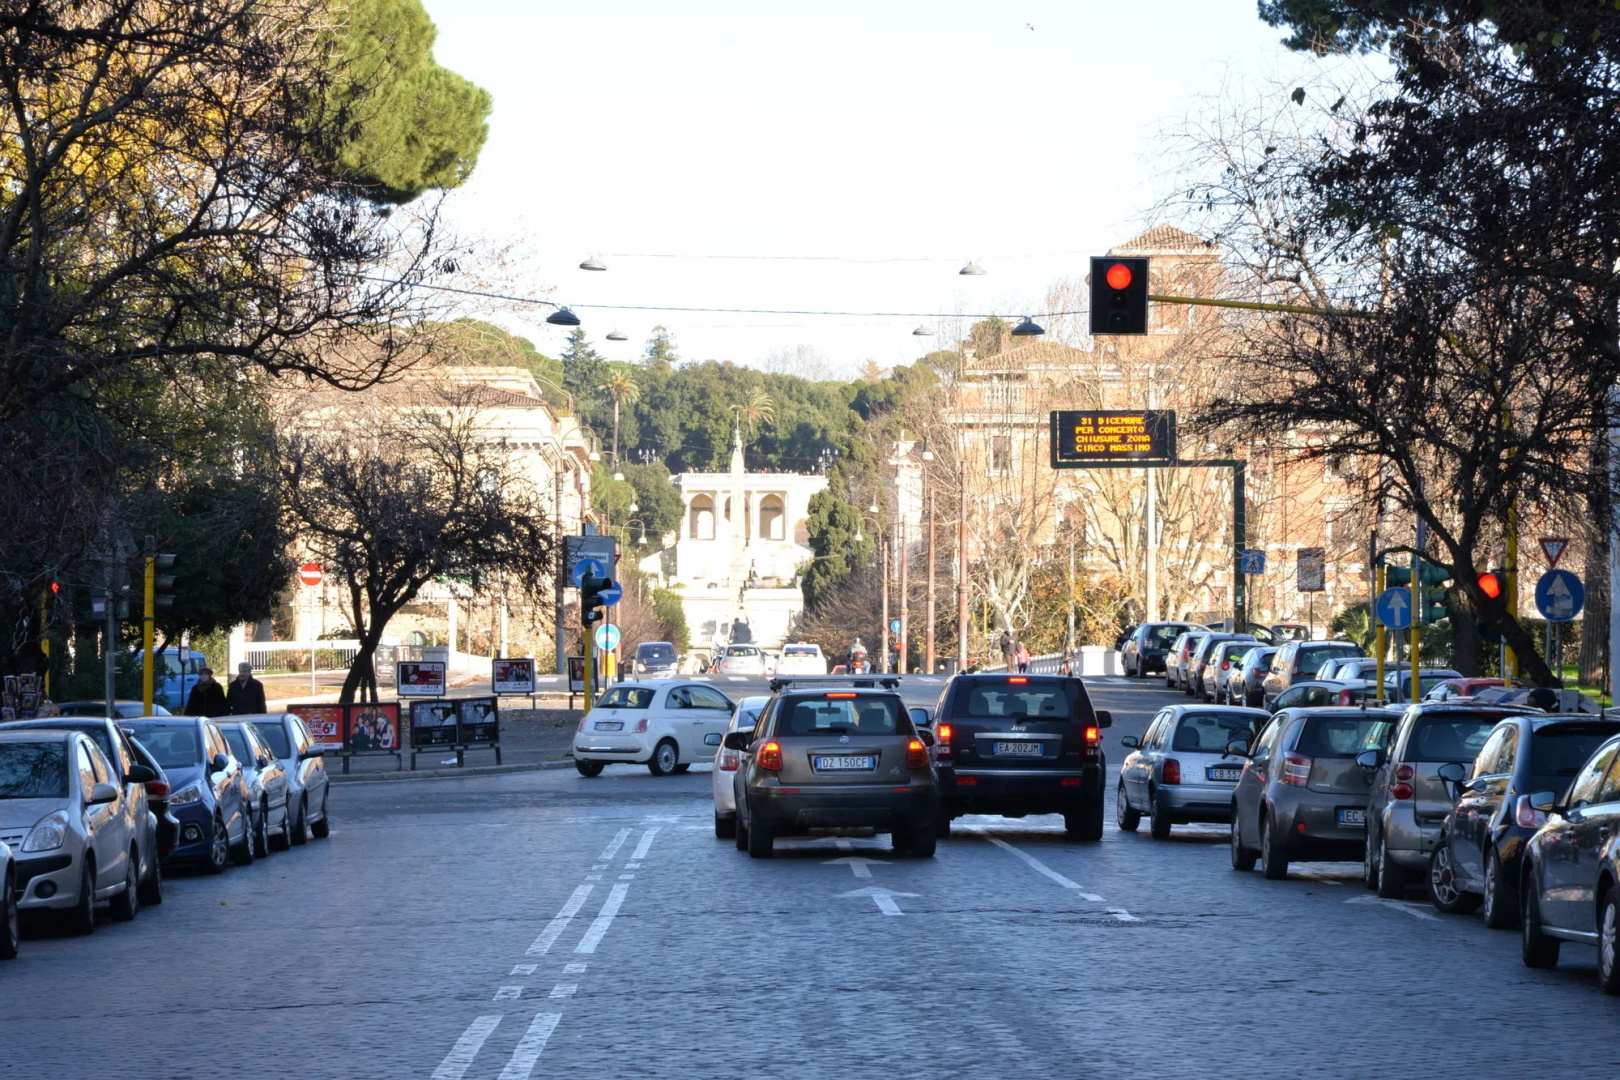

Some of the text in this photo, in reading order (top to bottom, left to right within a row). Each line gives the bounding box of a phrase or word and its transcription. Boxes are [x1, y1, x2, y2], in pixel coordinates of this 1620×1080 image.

[1081, 417, 1145, 425] 31 DICEMBRE
[1075, 426, 1145, 434] PER CONCERTO
[1075, 435, 1122, 443] CHIUSURE
[1075, 444, 1151, 452] CIRCO MASSIMO
[999, 743, 1039, 753] EA 202JM
[822, 757, 867, 768] DZ 150CF
[1214, 769, 1225, 779] CB
[1346, 810, 1359, 822] EC
